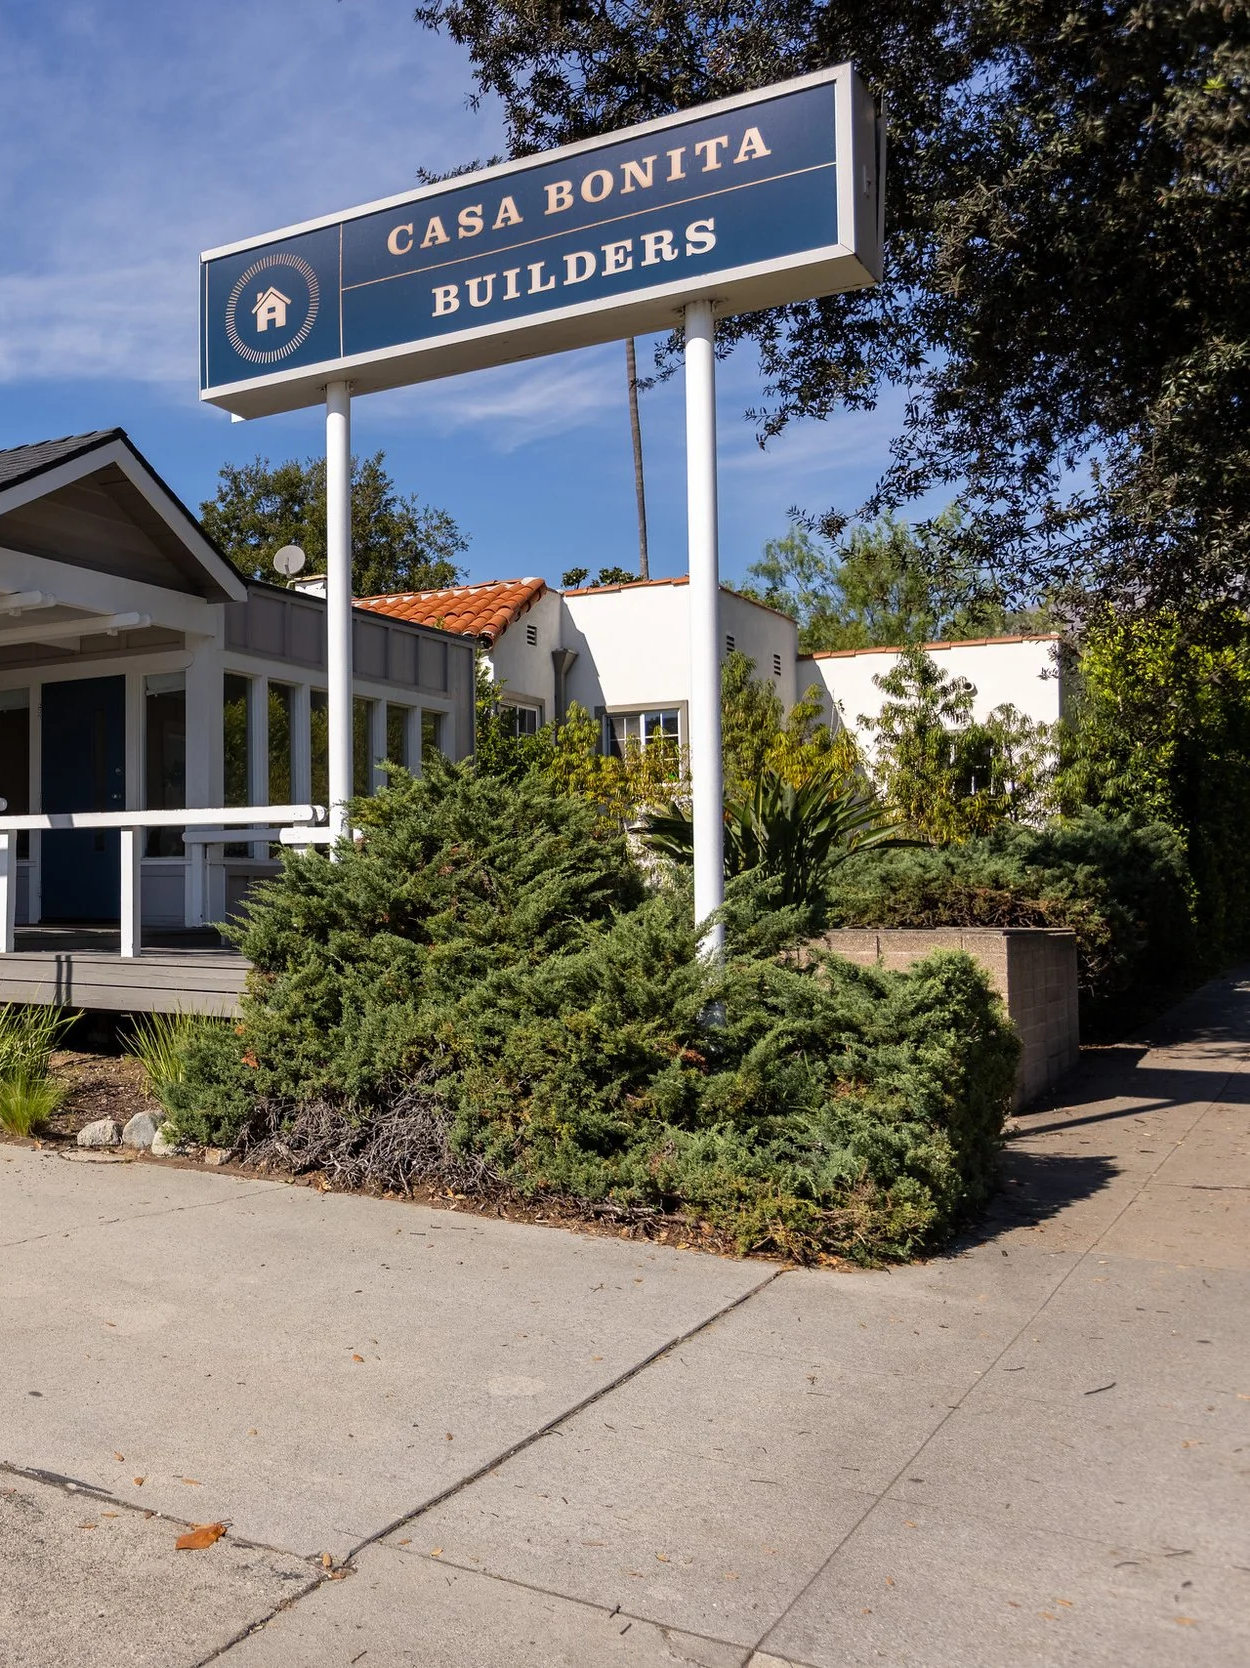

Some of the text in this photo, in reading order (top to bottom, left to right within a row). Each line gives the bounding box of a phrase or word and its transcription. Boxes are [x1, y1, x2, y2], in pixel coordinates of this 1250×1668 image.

[387, 127, 772, 256] CASA BONITA
[431, 217, 717, 318] BUILDERS
